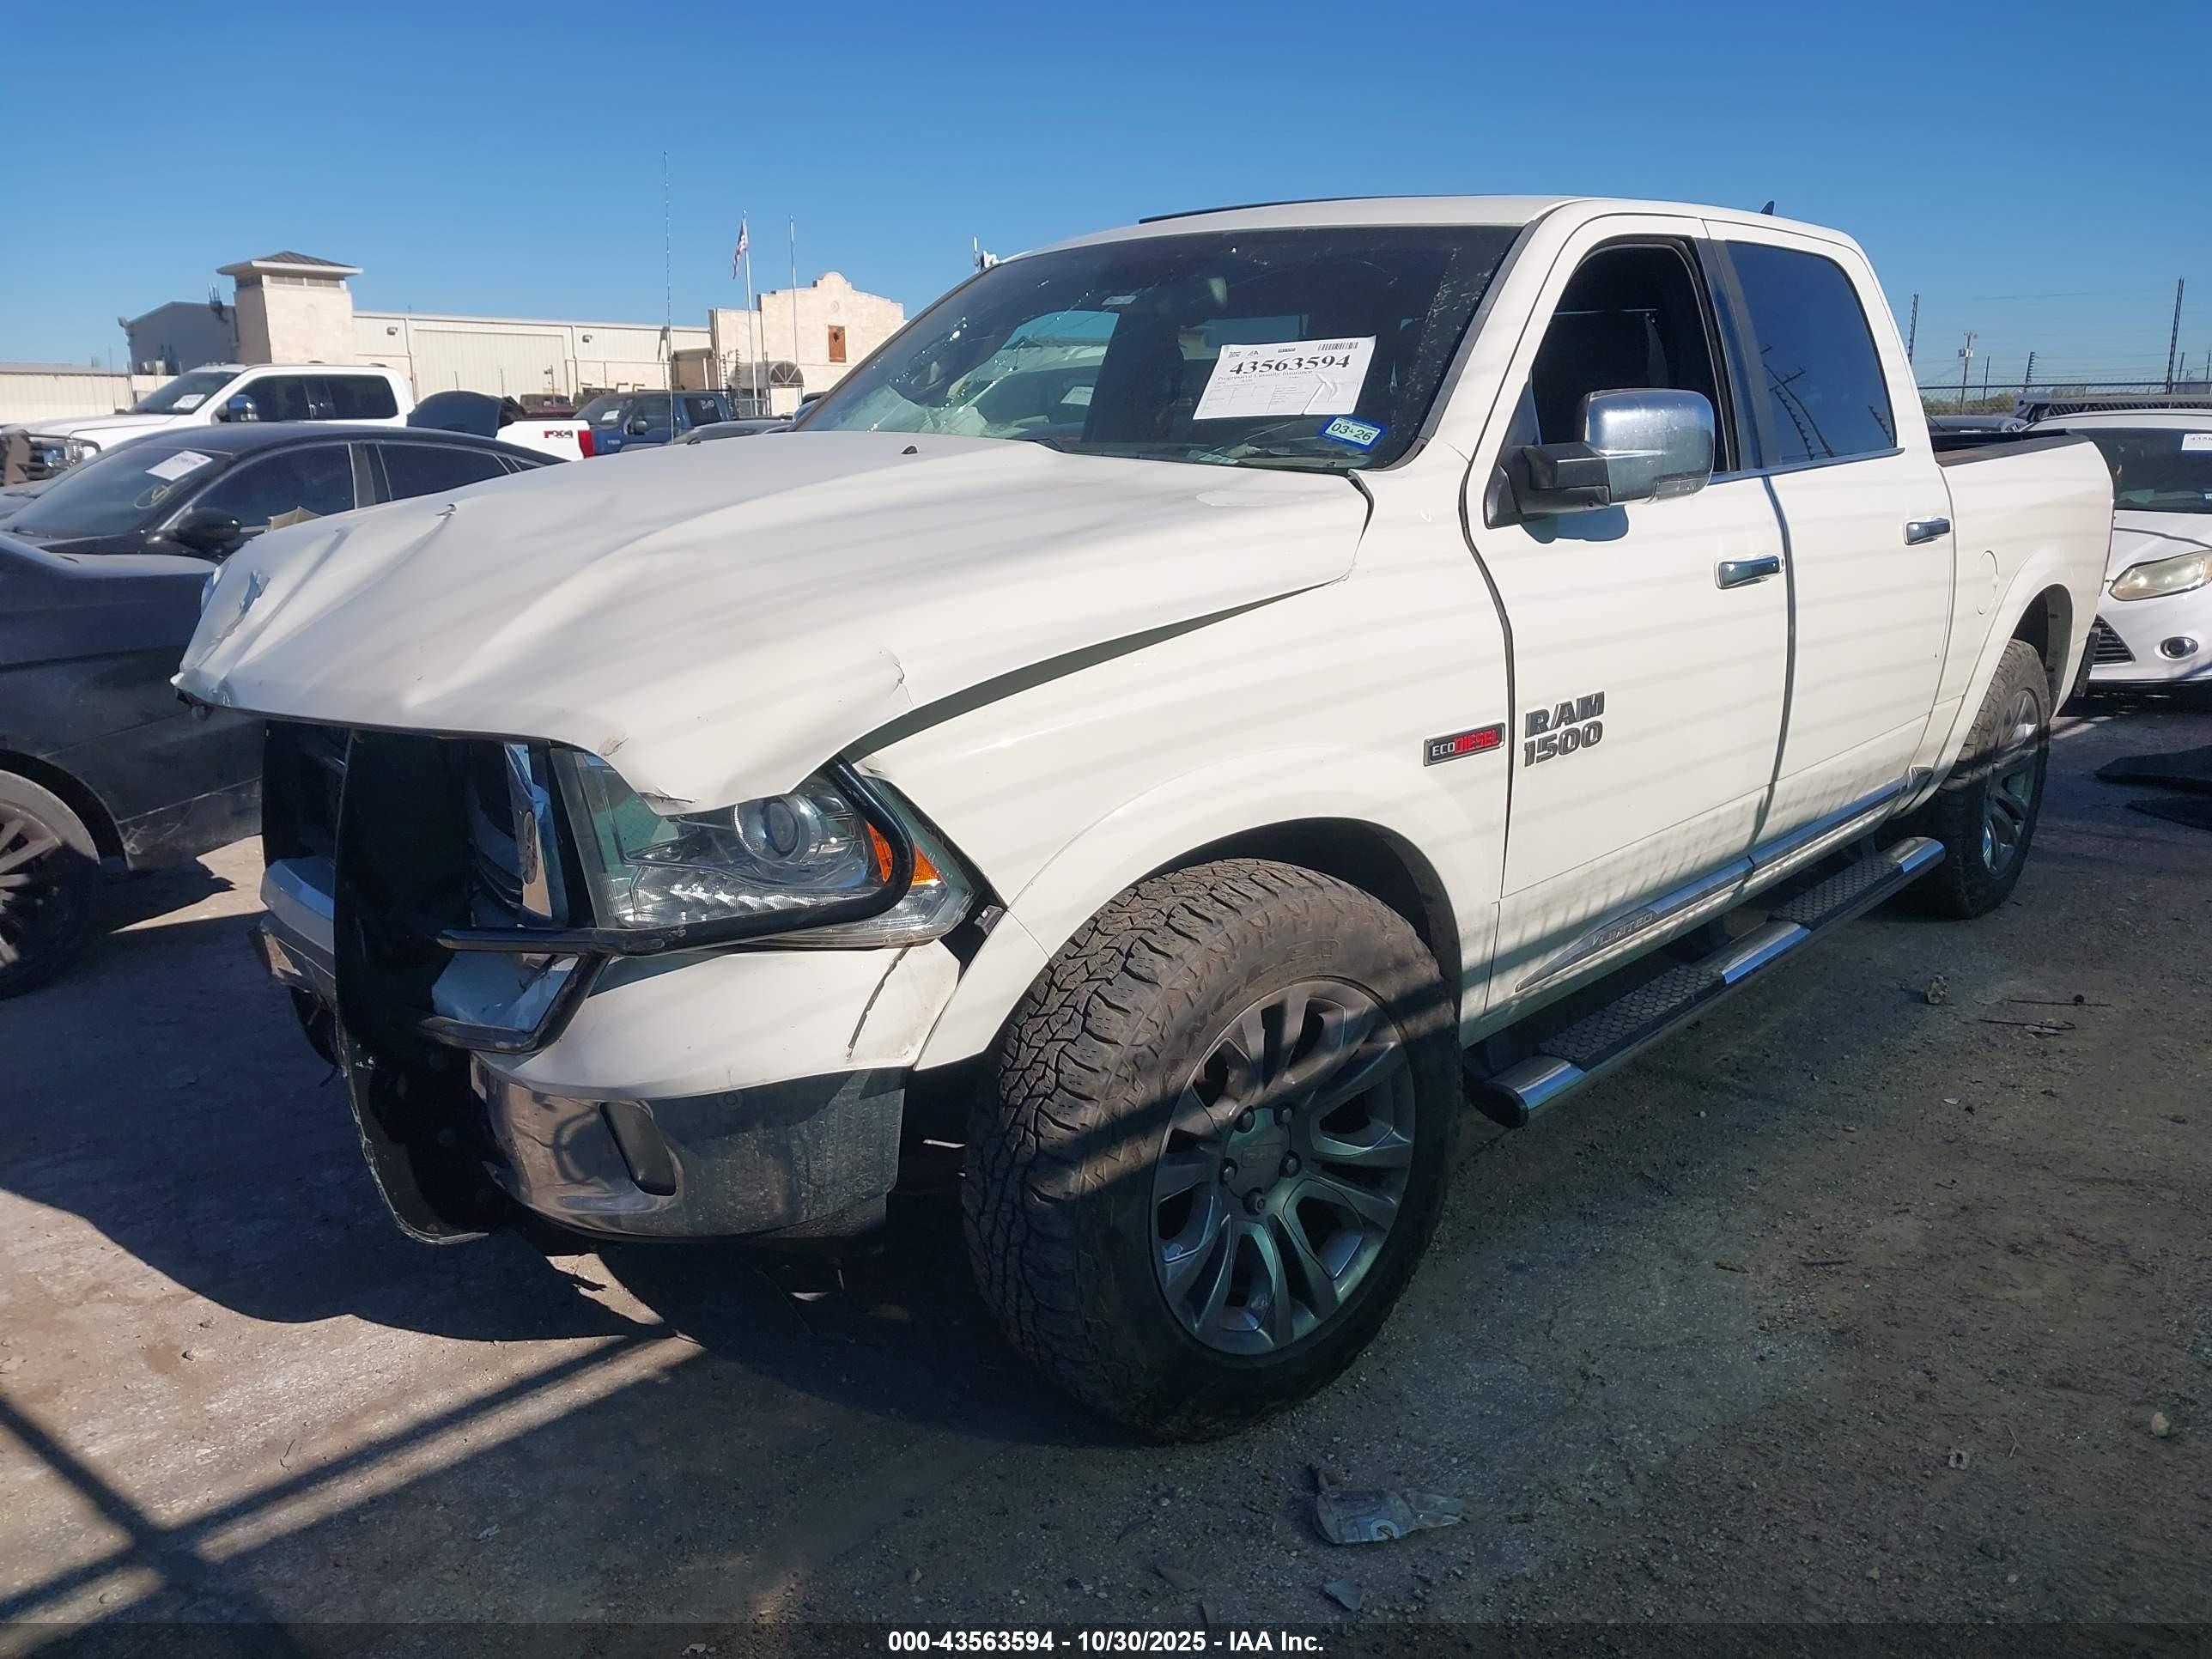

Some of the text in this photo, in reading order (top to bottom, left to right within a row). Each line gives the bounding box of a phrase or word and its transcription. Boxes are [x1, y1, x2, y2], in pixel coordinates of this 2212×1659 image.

[1229, 354, 1351, 374] 43563594
[544, 430, 574, 439] FX4
[1331, 422, 1350, 434] 03
[1352, 429, 1373, 441] 26
[1525, 691, 1605, 738] RAM
[1431, 728, 1499, 757] ECODIESEL
[1524, 720, 1603, 767] 1500
